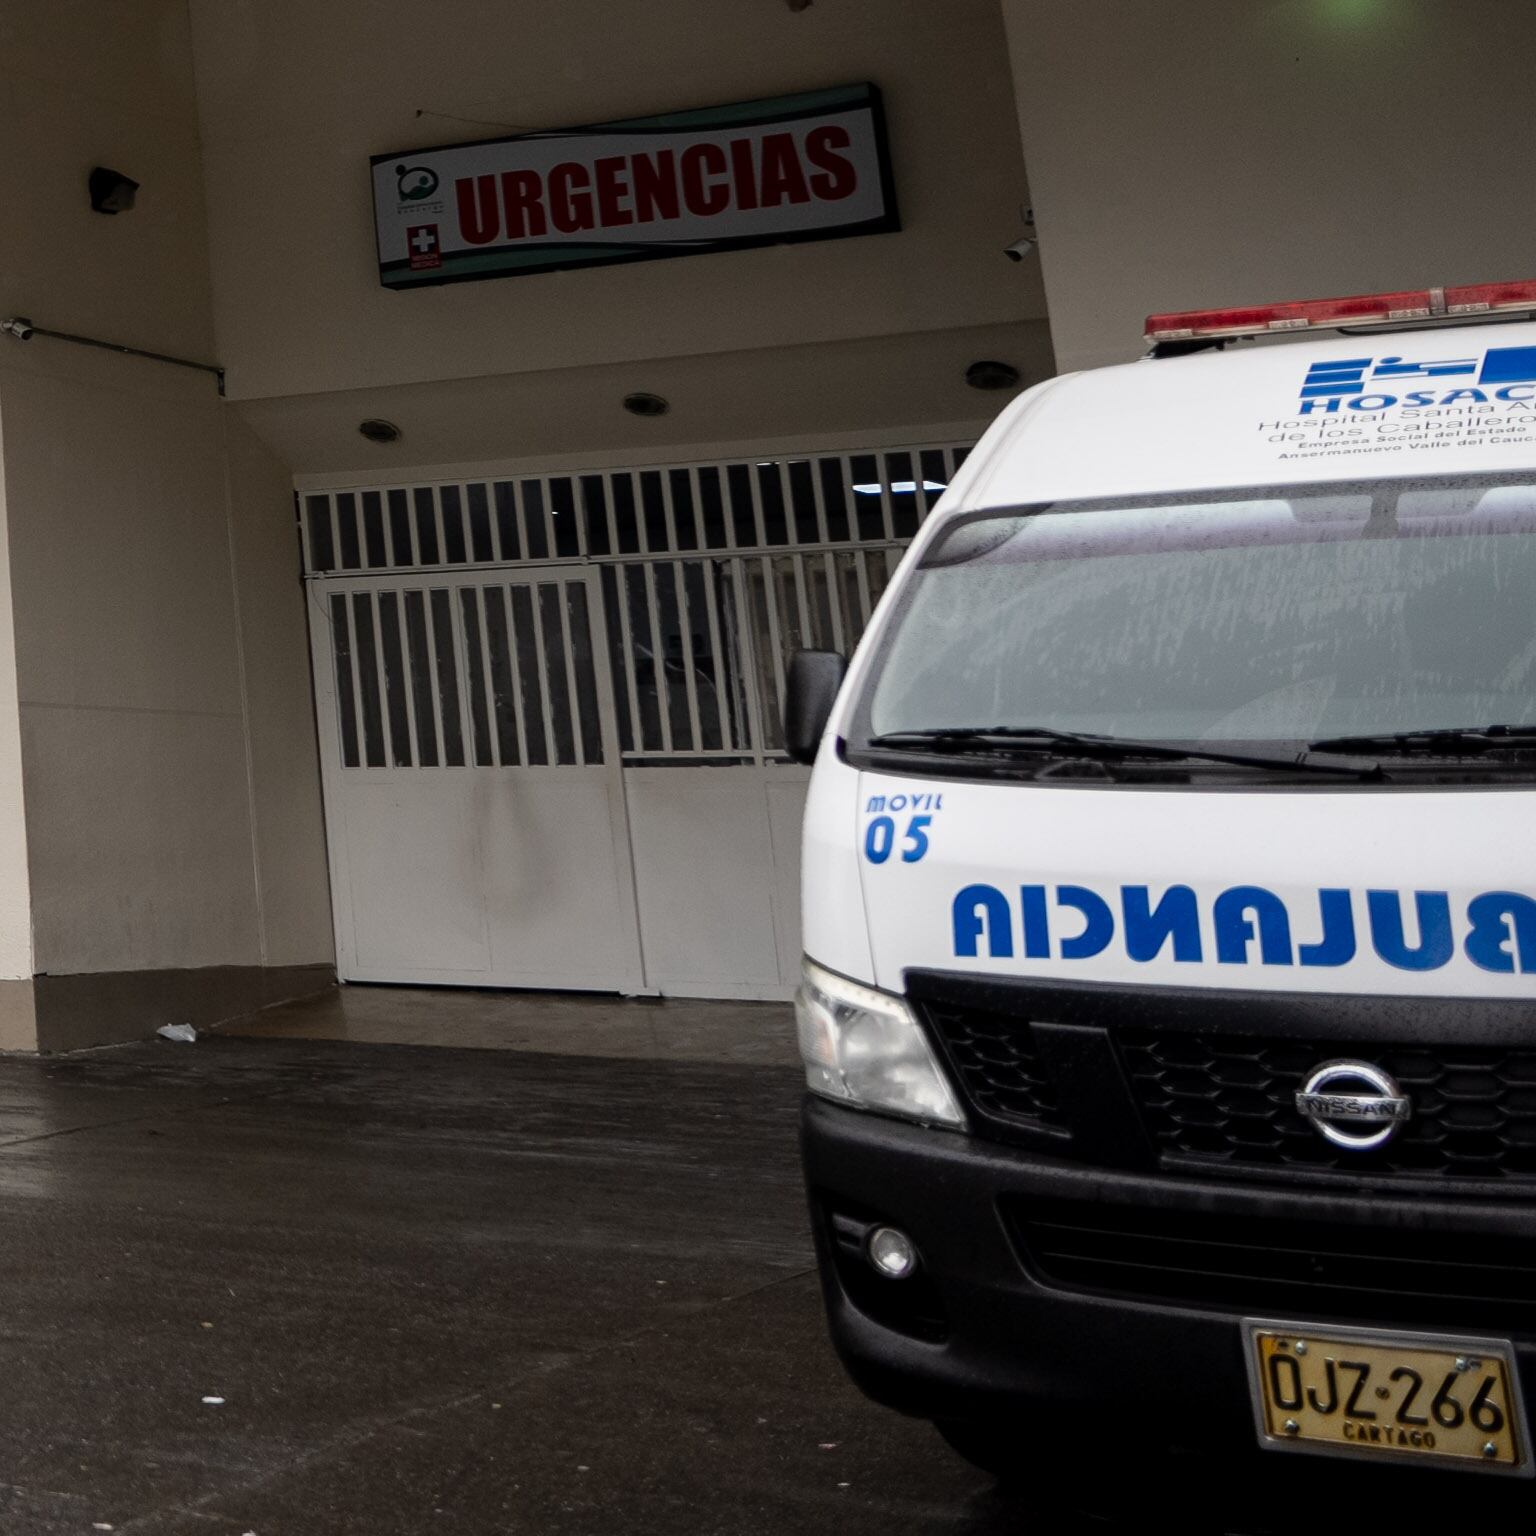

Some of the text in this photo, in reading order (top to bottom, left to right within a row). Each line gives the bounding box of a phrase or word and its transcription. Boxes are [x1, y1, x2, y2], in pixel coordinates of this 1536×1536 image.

[455, 125, 857, 245] URGENCIAS
[1258, 412, 1385, 431] Hospital
[1399, 406, 1495, 419] Santa
[1268, 433, 1306, 442] de
[1319, 429, 1363, 439] los
[1298, 426, 1527, 449] Empresa Social del Estado
[1278, 445, 1402, 459] Ansermanuevo
[1409, 441, 1451, 450] Valle
[1457, 438, 1483, 446] del
[865, 815, 932, 864] 05
[1306, 1099, 1397, 1116] NISSAN
[1343, 1420, 1436, 1449] CARTAGO
